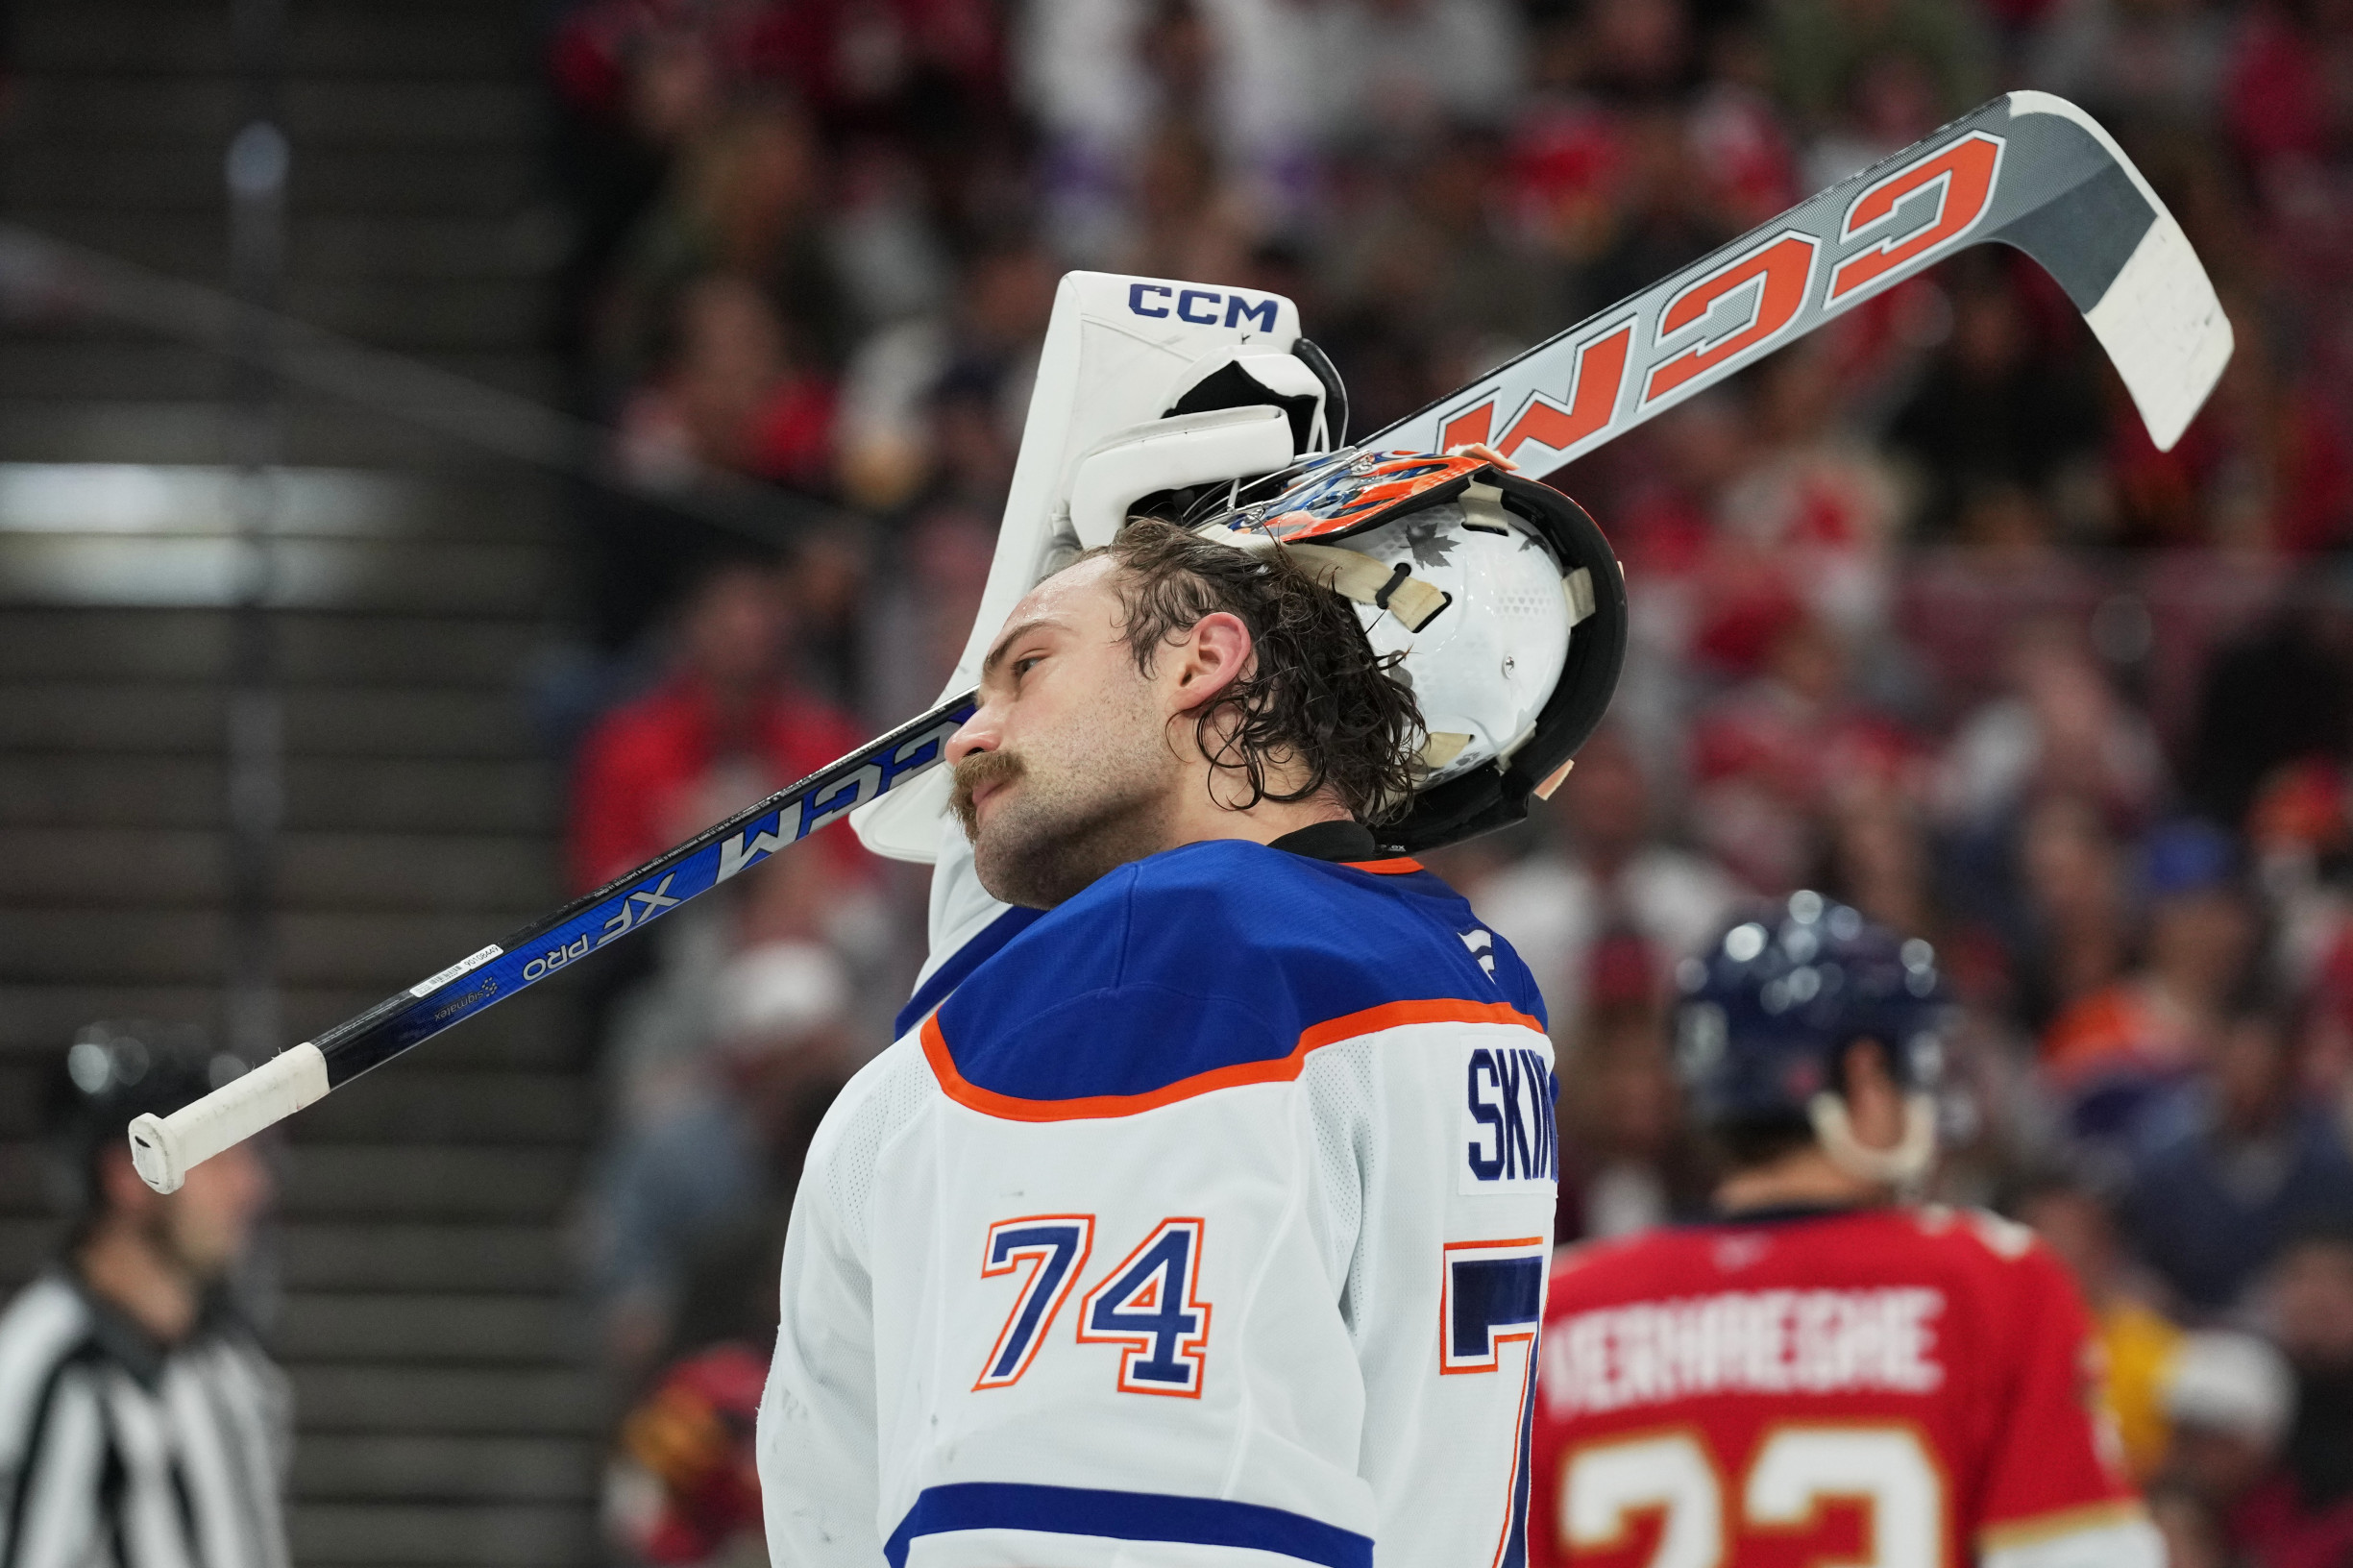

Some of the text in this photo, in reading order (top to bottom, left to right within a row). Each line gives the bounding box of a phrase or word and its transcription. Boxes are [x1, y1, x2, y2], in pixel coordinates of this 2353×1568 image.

[1128, 283, 1279, 332] CCM
[1437, 129, 2006, 461] CCM
[715, 722, 965, 886] CCM
[522, 870, 681, 982] XF PRO
[433, 990, 484, 1022] sigmatex
[970, 1213, 1213, 1400] 74
